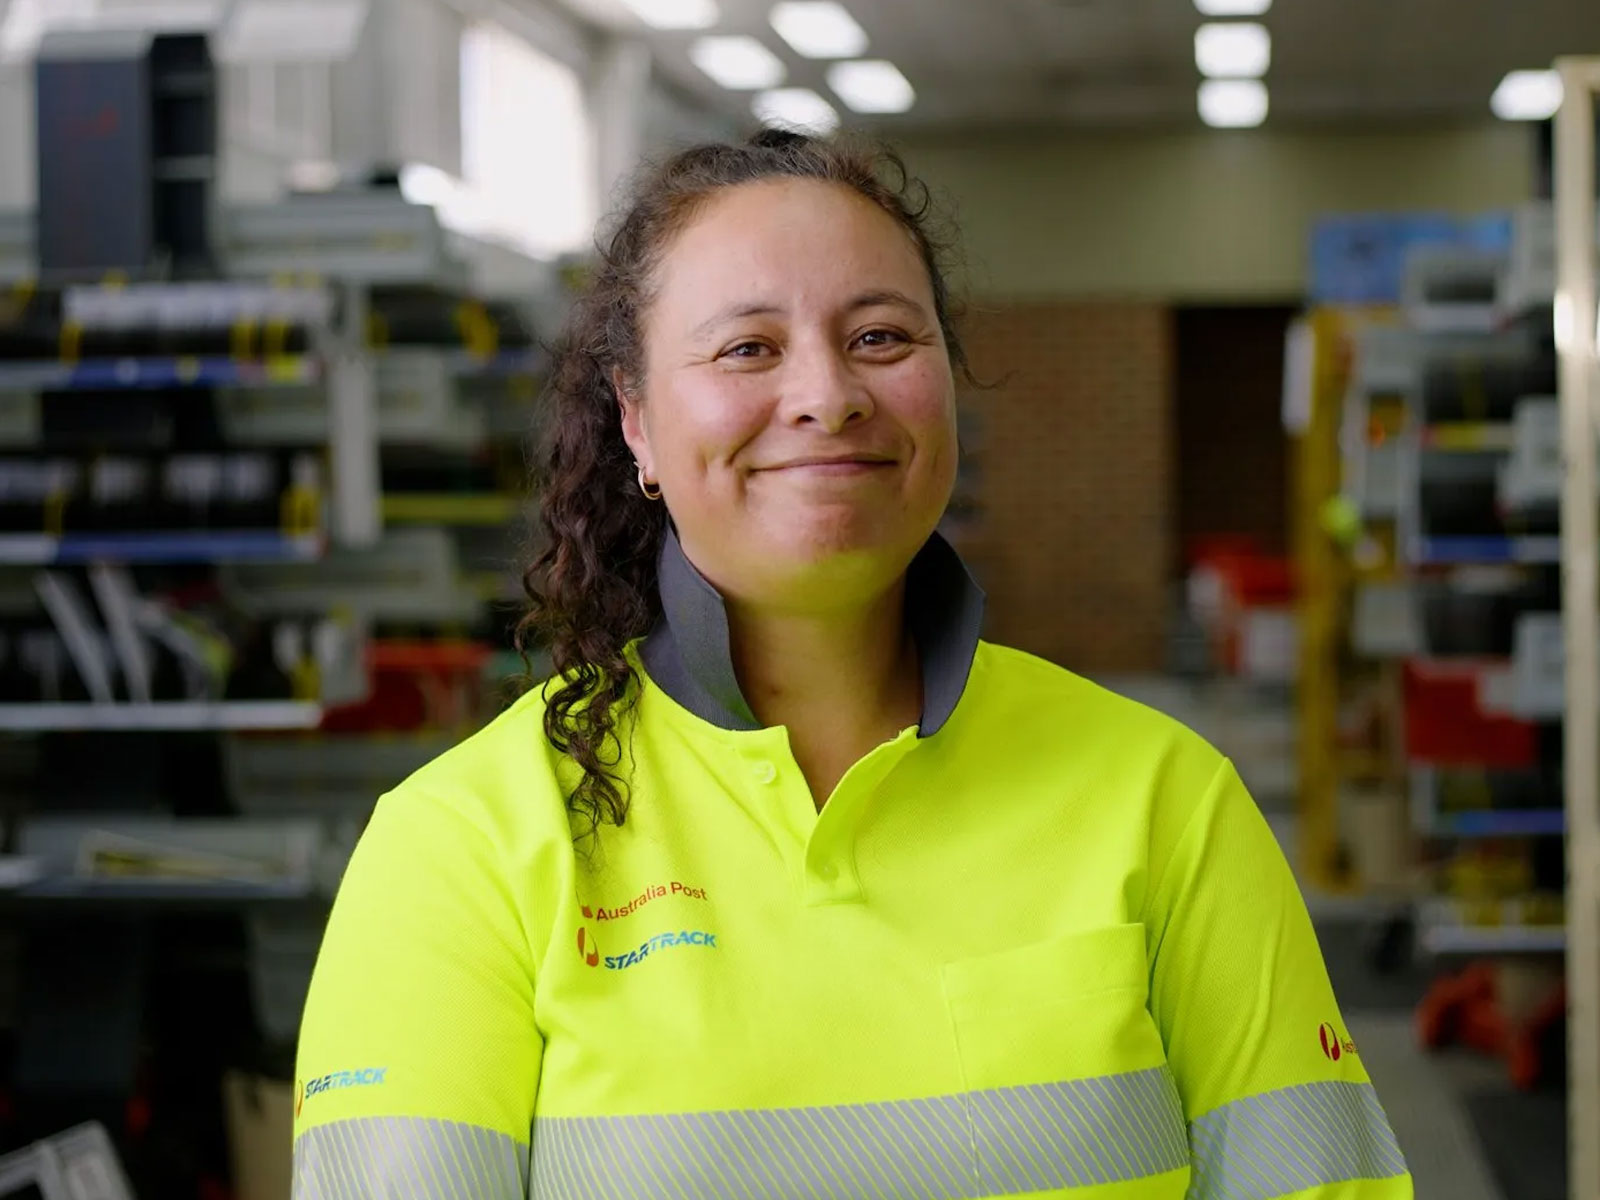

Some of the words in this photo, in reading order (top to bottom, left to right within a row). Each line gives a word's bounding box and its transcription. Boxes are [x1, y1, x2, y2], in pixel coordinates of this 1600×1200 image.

[596, 885, 667, 921] Australia
[670, 881, 708, 901] Post
[604, 931, 716, 970] STARTRACK
[305, 1067, 386, 1099] STARTRACK
